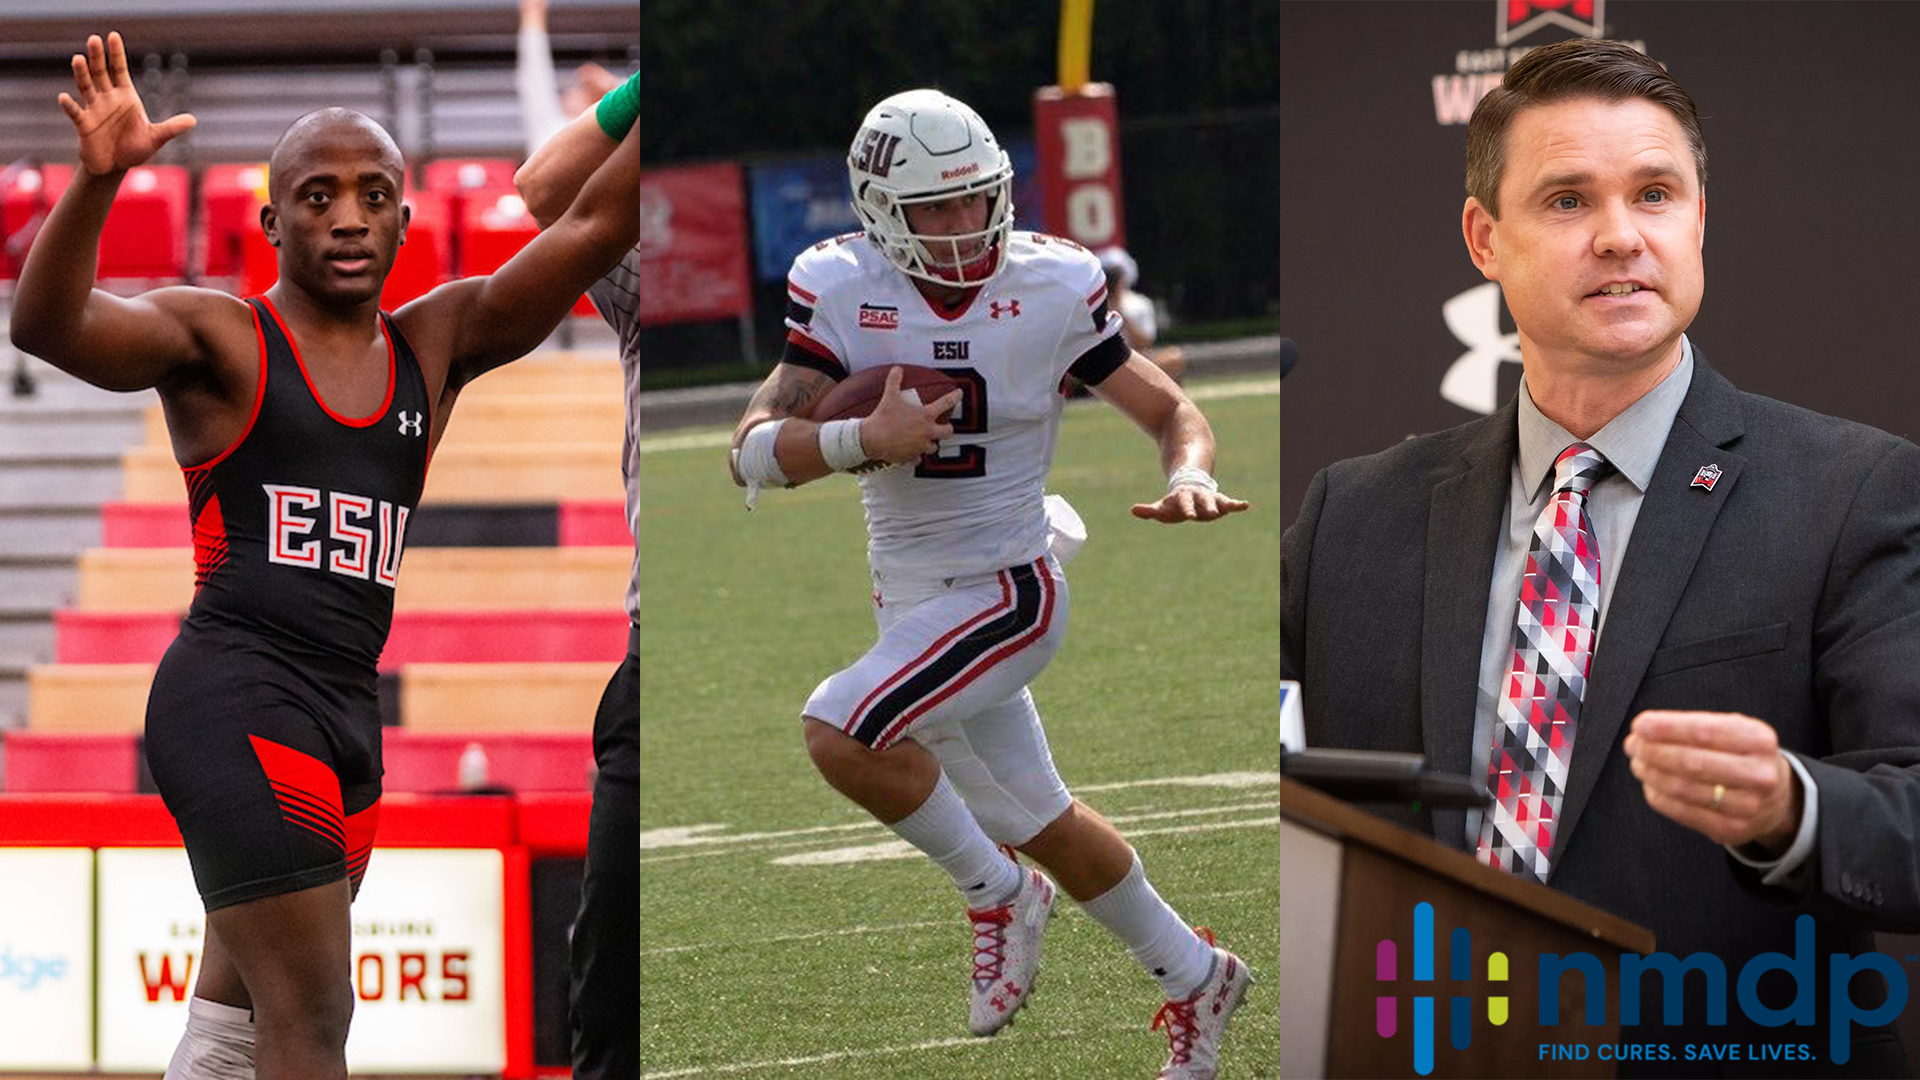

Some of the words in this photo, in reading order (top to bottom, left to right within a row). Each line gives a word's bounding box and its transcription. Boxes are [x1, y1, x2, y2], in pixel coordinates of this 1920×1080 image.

[941, 162, 980, 181] Riddell
[859, 310, 900, 324] PSAC
[932, 341, 971, 361] ESU
[913, 366, 989, 479] 2
[261, 484, 410, 589] ESU
